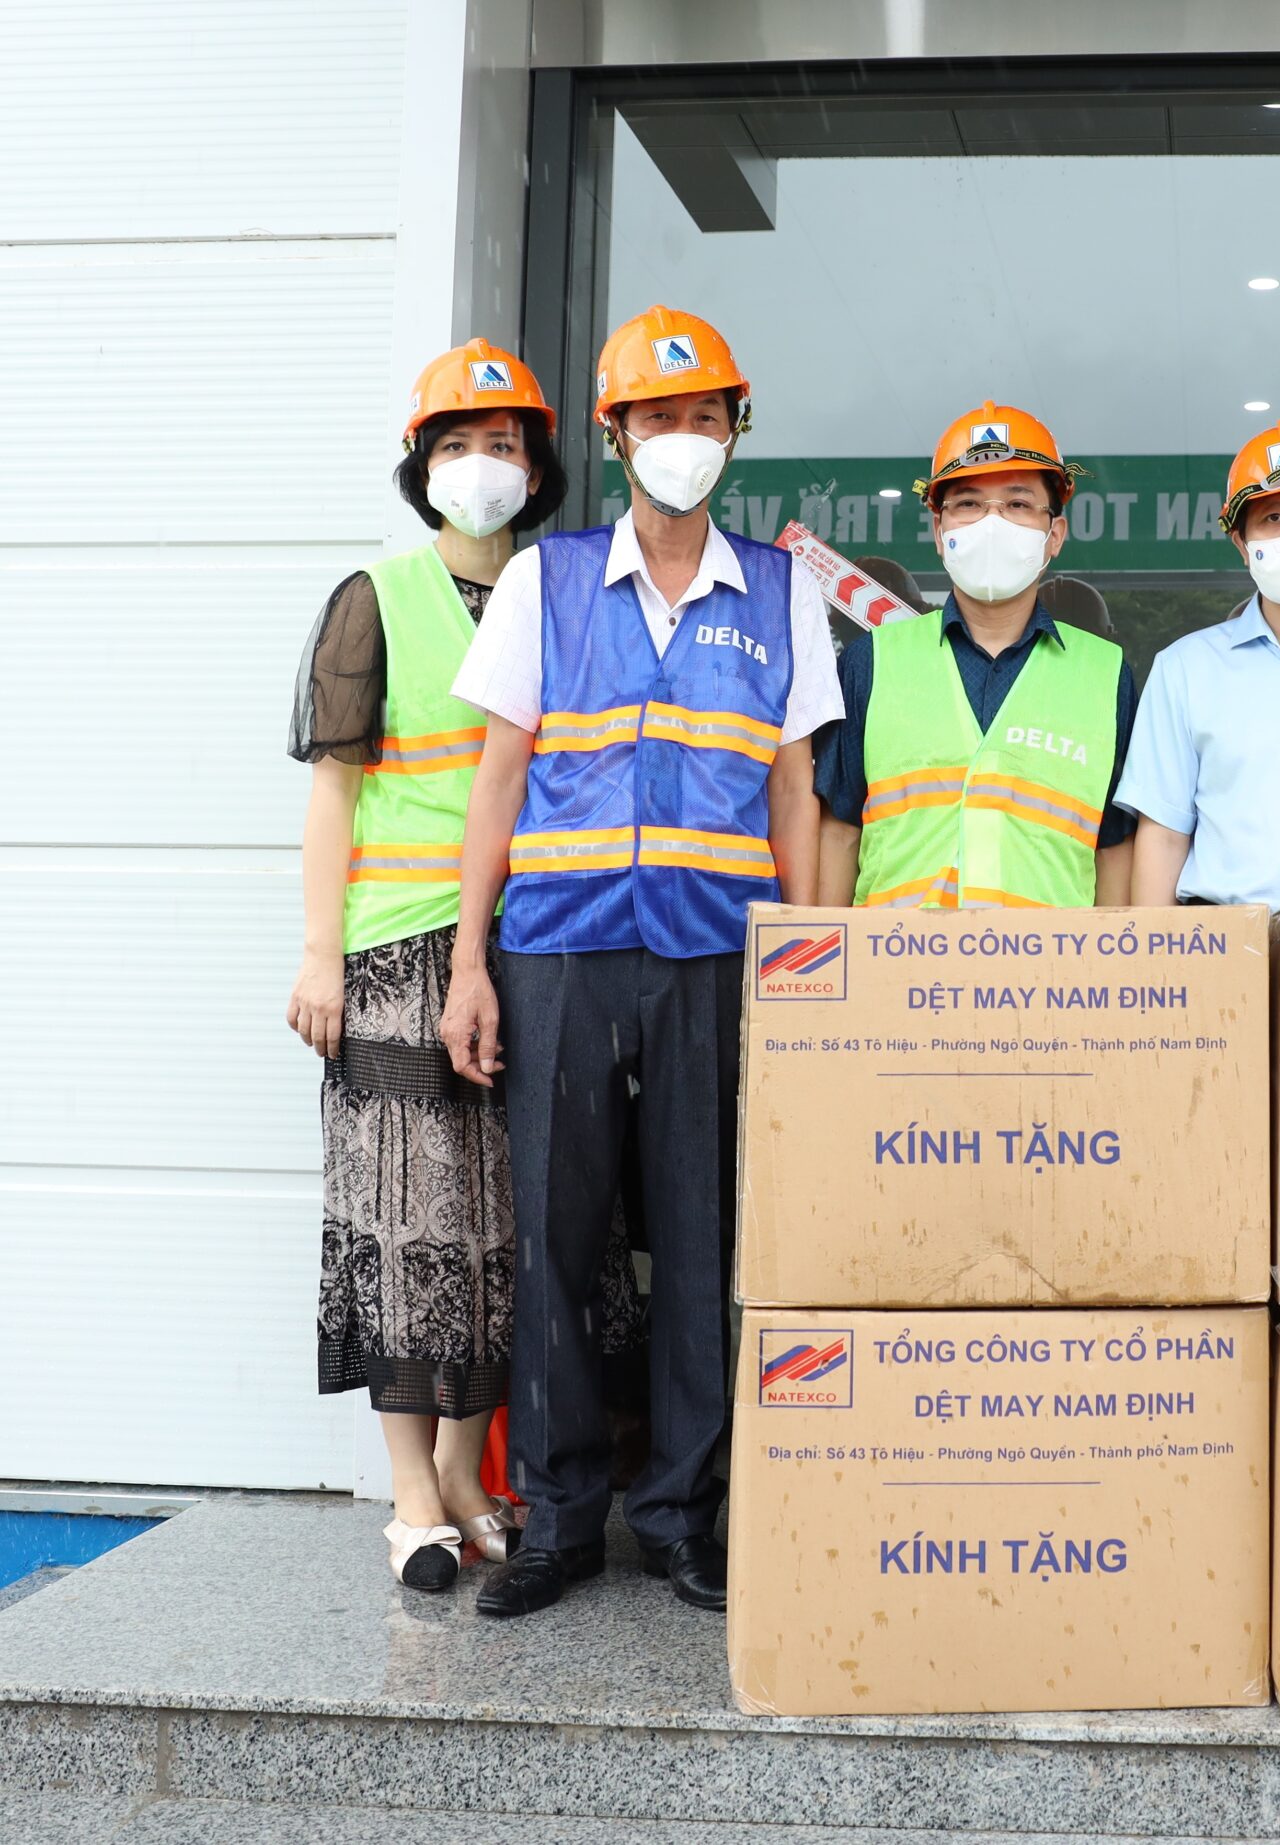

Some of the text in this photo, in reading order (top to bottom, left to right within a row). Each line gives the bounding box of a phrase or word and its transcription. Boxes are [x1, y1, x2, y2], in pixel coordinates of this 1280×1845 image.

[664, 359, 694, 369] DELTA
[695, 623, 768, 665] DELTA
[1006, 726, 1087, 766] DELTA
[866, 921, 1228, 958] TỔNG CÔNG TY CỔ PHẦN
[765, 983, 833, 993] NATEXCO
[907, 982, 1188, 1014] DỆT MAY NAM ĐỊNH
[764, 1038, 789, 1054] Địa
[789, 1039, 816, 1053] chỉ:
[820, 1035, 842, 1053] Số
[842, 1039, 861, 1054] 43
[864, 1038, 884, 1054] Tô
[885, 1039, 919, 1053] Hiệu
[929, 1037, 987, 1055] Phường
[989, 1039, 1020, 1055] Ngô
[1081, 1036, 1127, 1052] Thành
[1127, 1037, 1157, 1055] phố
[1159, 1037, 1193, 1051] Nam
[1193, 1035, 1228, 1051] Định
[874, 1121, 1121, 1176] KÍNH TẶNG
[873, 1328, 1236, 1365] TỔNG CÔNG TY CỔ PHẦN
[767, 1392, 837, 1403] NATEXCO
[913, 1388, 1196, 1423] DỆT MAY NAM ĐỊNH
[767, 1444, 793, 1461] Địa
[794, 1444, 821, 1461] chỉ:
[825, 1445, 847, 1462] Số
[847, 1445, 867, 1461] 43
[870, 1446, 890, 1461] Tô
[891, 1447, 927, 1462] Hiệu
[936, 1446, 994, 1464] Phường
[995, 1447, 1028, 1464] Ngô
[1089, 1444, 1134, 1460] Thành
[1135, 1444, 1166, 1460] phố
[1166, 1444, 1200, 1457] Nam
[1200, 1440, 1234, 1456] Định
[879, 1530, 1129, 1583] KÍNH TẶNG
